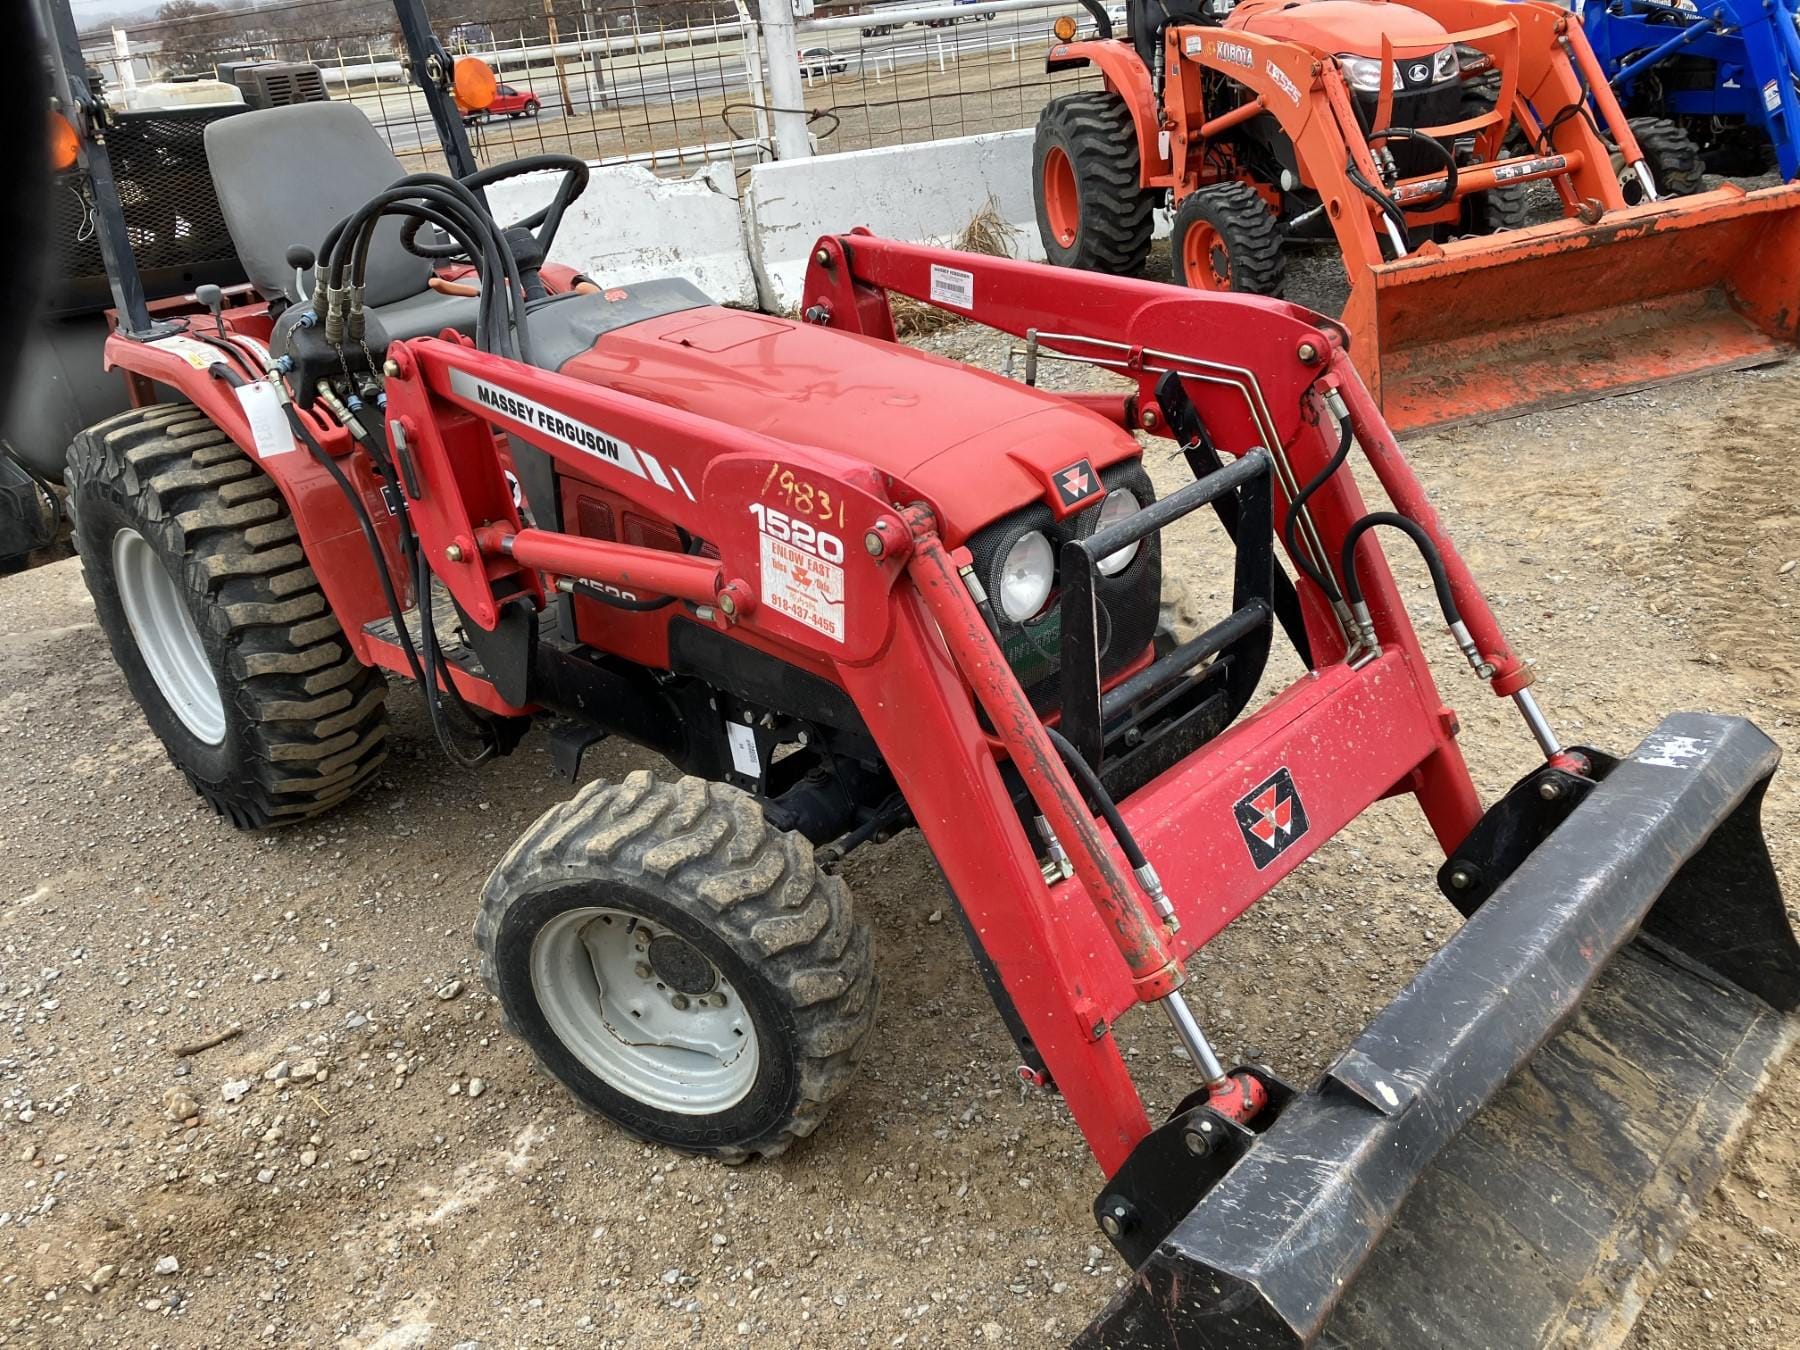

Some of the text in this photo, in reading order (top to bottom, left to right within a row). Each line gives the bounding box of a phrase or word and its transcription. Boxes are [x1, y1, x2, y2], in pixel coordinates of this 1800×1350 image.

[1217, 41, 1254, 68] KUBOTA
[477, 384, 619, 461] MASSEY FERGUSON
[761, 463, 844, 529] 19831
[748, 503, 844, 564] 1520
[771, 542, 831, 578] ENLOW EAST
[771, 593, 835, 634] 918-437-4455
